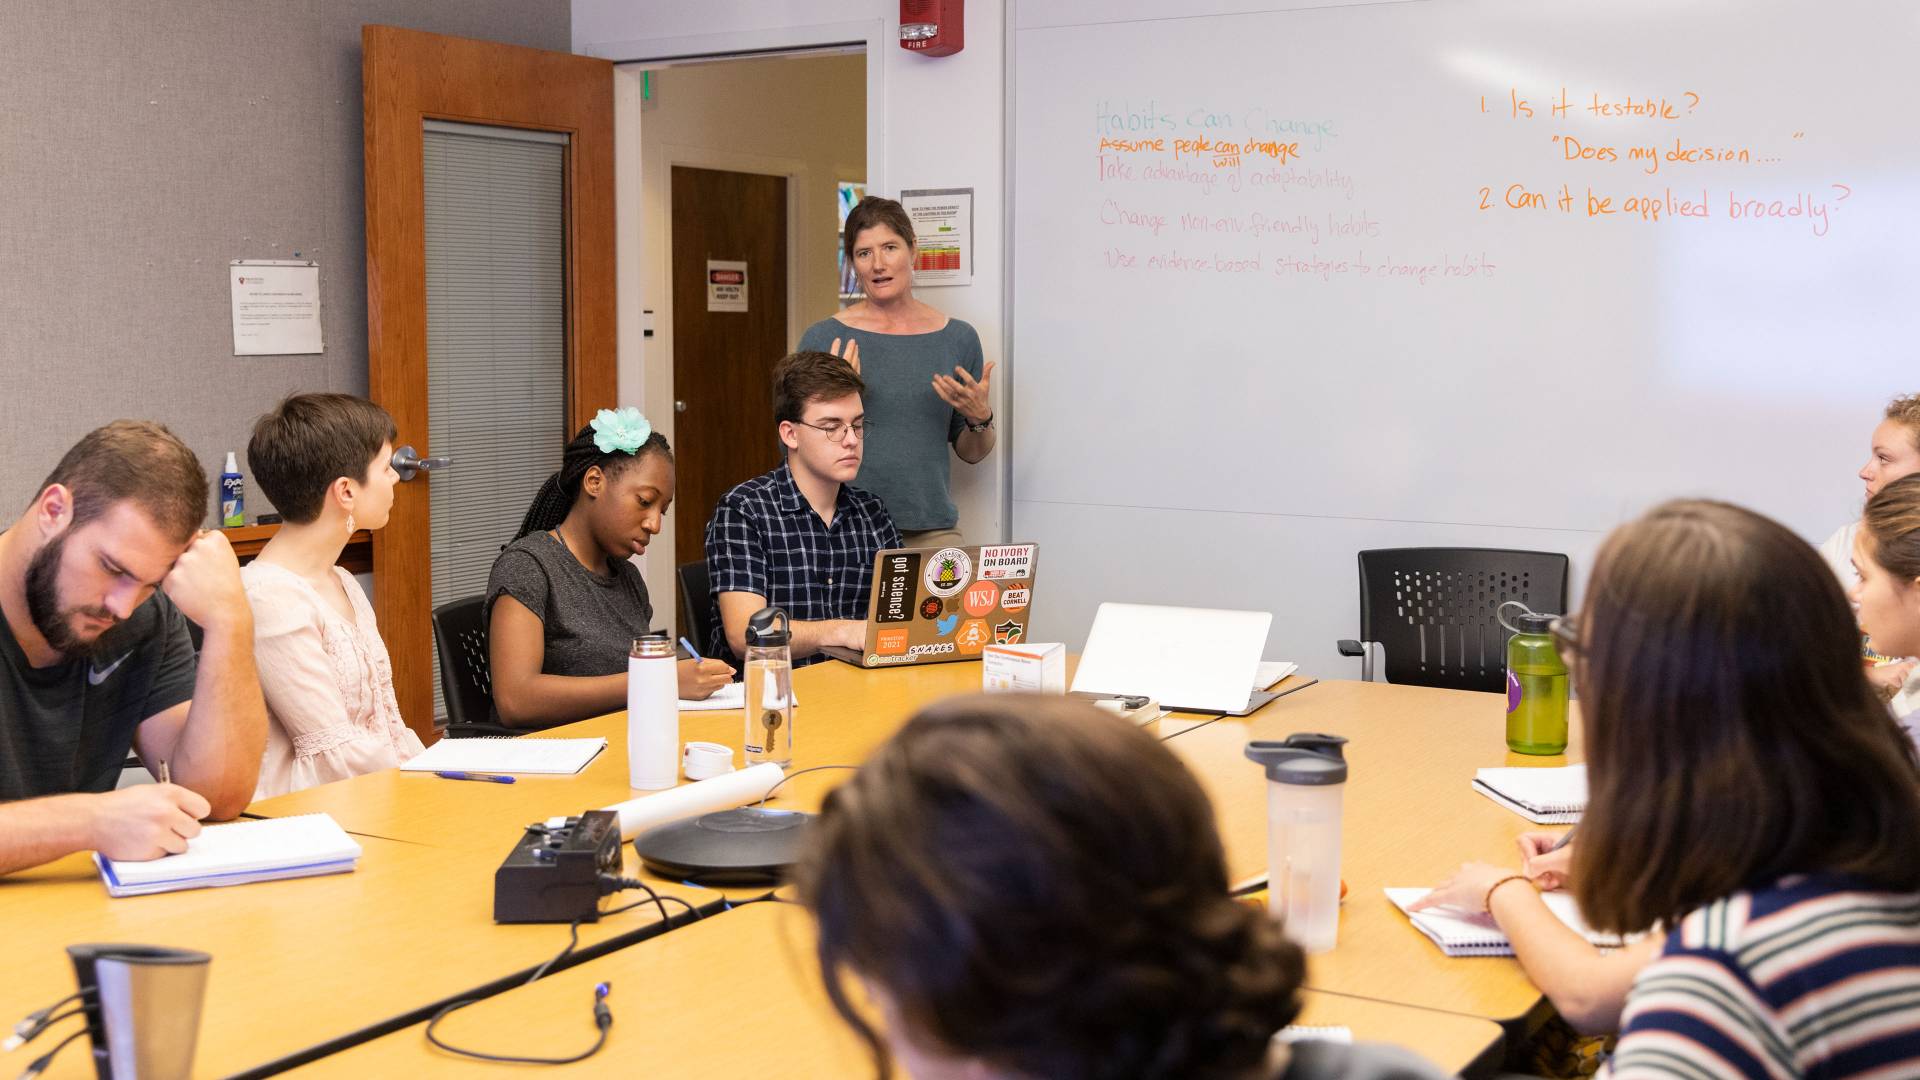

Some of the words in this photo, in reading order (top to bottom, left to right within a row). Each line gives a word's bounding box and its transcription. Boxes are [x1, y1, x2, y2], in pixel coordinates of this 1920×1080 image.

[1480, 96, 1490, 113] 1.
[1512, 88, 1533, 119] Is
[1551, 87, 1574, 120] it
[1095, 101, 1177, 138] Habits
[1186, 107, 1232, 131] Can
[1244, 106, 1339, 152] Change
[1099, 137, 1165, 154] Assume
[1213, 140, 1240, 157] can
[1243, 139, 1301, 165] change
[1213, 155, 1241, 168] will
[1628, 144, 1658, 175] my
[1097, 155, 1136, 183] Take
[1143, 163, 1218, 197] advantage
[1226, 166, 1243, 192] of
[1250, 168, 1355, 199] adaptability
[1479, 188, 1496, 211] 2.
[1505, 183, 1547, 210] Can
[1557, 183, 1574, 214] it
[1587, 186, 1617, 217] be
[1623, 188, 1710, 222] applied
[1099, 199, 1169, 237] Change
[1249, 211, 1319, 245] friendly
[1328, 213, 1380, 237] habits
[1103, 247, 1137, 270] Use
[1275, 256, 1348, 282] strategies
[1352, 250, 1370, 275] to
[1376, 254, 1437, 286] change
[1443, 252, 1497, 279] habits
[892, 557, 909, 573] got
[984, 549, 998, 557] NO
[1000, 547, 1029, 557] IVORY
[984, 558, 997, 567] ON
[998, 557, 1028, 566] BOARD
[888, 576, 909, 620] science?
[969, 589, 995, 607] WSJ
[1007, 591, 1025, 599] BEAT
[883, 641, 900, 649] 2021
[910, 643, 954, 655] SNAKES
